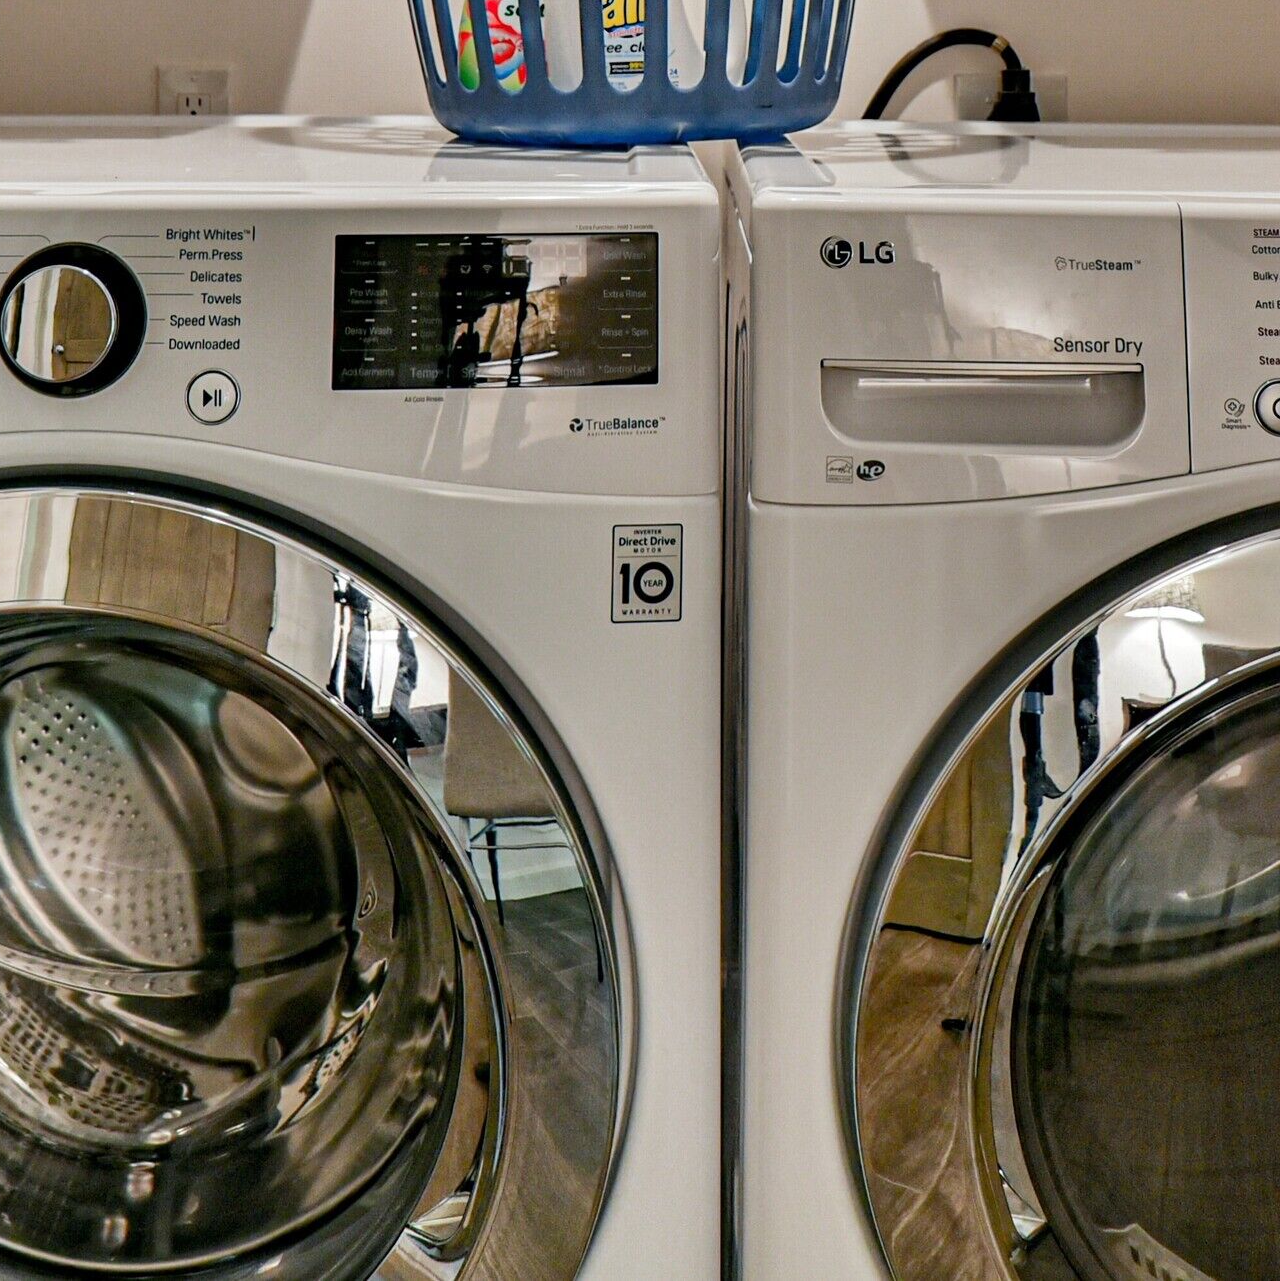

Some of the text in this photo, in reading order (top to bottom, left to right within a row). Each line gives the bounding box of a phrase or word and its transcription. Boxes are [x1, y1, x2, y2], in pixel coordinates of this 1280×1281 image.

[166, 229, 200, 242] Bright
[1253, 229, 1280, 237] STEAM
[859, 241, 896, 264] LG
[190, 271, 242, 282] Delicates
[201, 293, 241, 304] Towels
[1255, 300, 1275, 309] Anti
[170, 315, 241, 328] Speed Wash
[169, 338, 240, 350] Downloaded
[1053, 337, 1143, 357] Sensor Dry
[619, 537, 676, 546] Direct Drive
[619, 561, 674, 605] 10
[643, 579, 663, 587] YEAR
